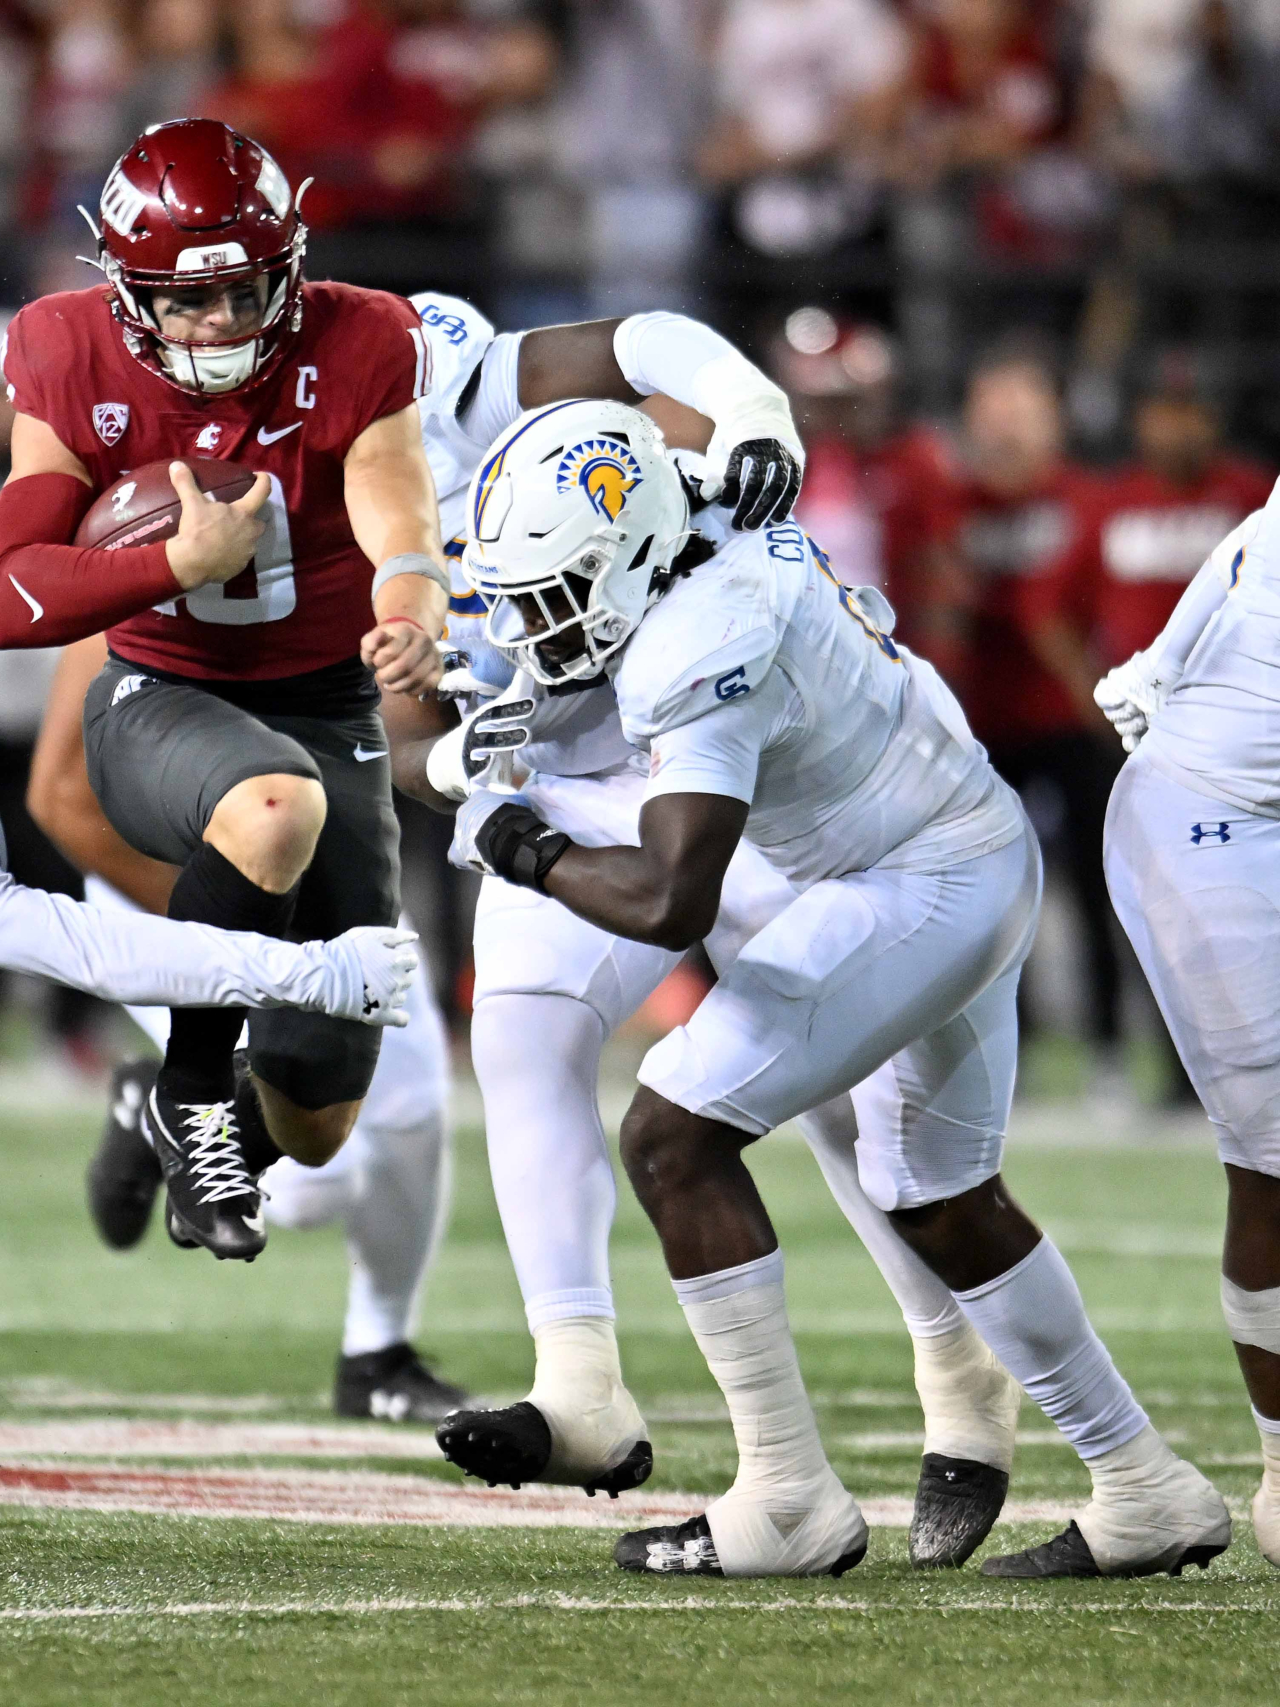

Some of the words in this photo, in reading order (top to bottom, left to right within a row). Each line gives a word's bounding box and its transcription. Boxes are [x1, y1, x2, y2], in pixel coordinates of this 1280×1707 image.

[200, 251, 227, 268] WSU
[295, 365, 318, 409] C
[94, 404, 128, 430] PAC
[102, 420, 119, 437] 12
